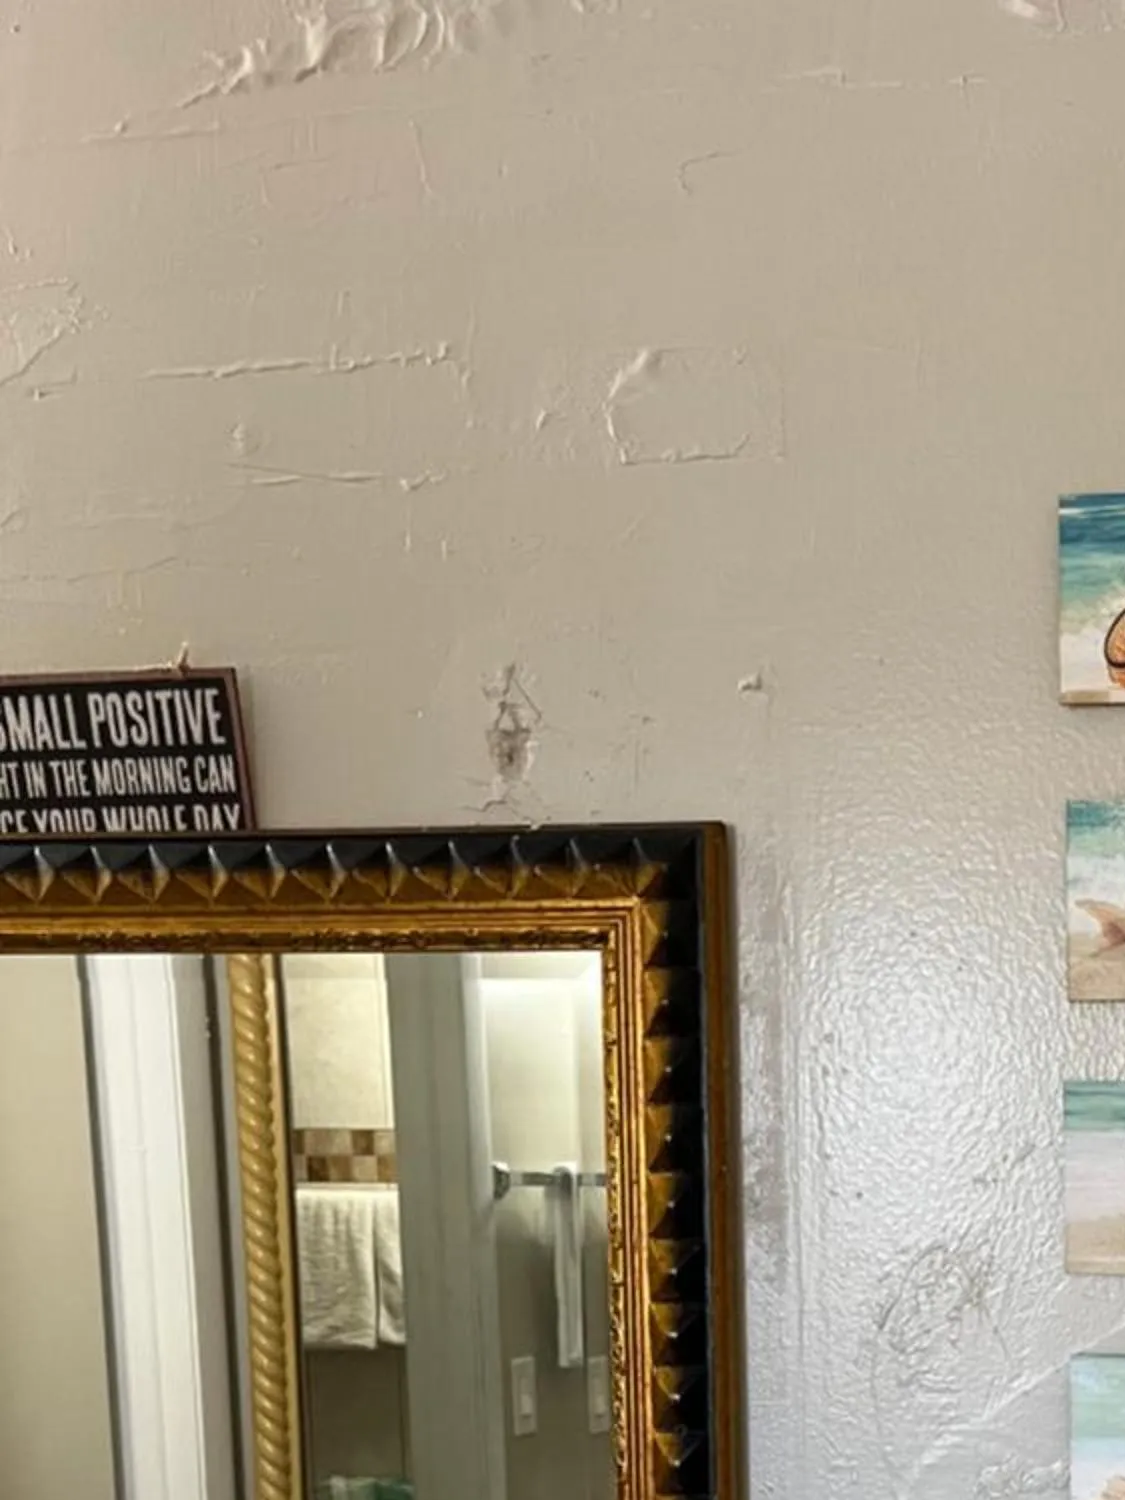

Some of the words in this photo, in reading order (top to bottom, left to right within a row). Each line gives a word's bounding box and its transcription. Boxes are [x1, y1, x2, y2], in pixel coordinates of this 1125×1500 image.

[87, 687, 227, 749] POSITIVE
[22, 761, 48, 799] IN
[48, 758, 91, 798] THE
[92, 756, 192, 797] MORNING
[194, 754, 237, 794] CAN
